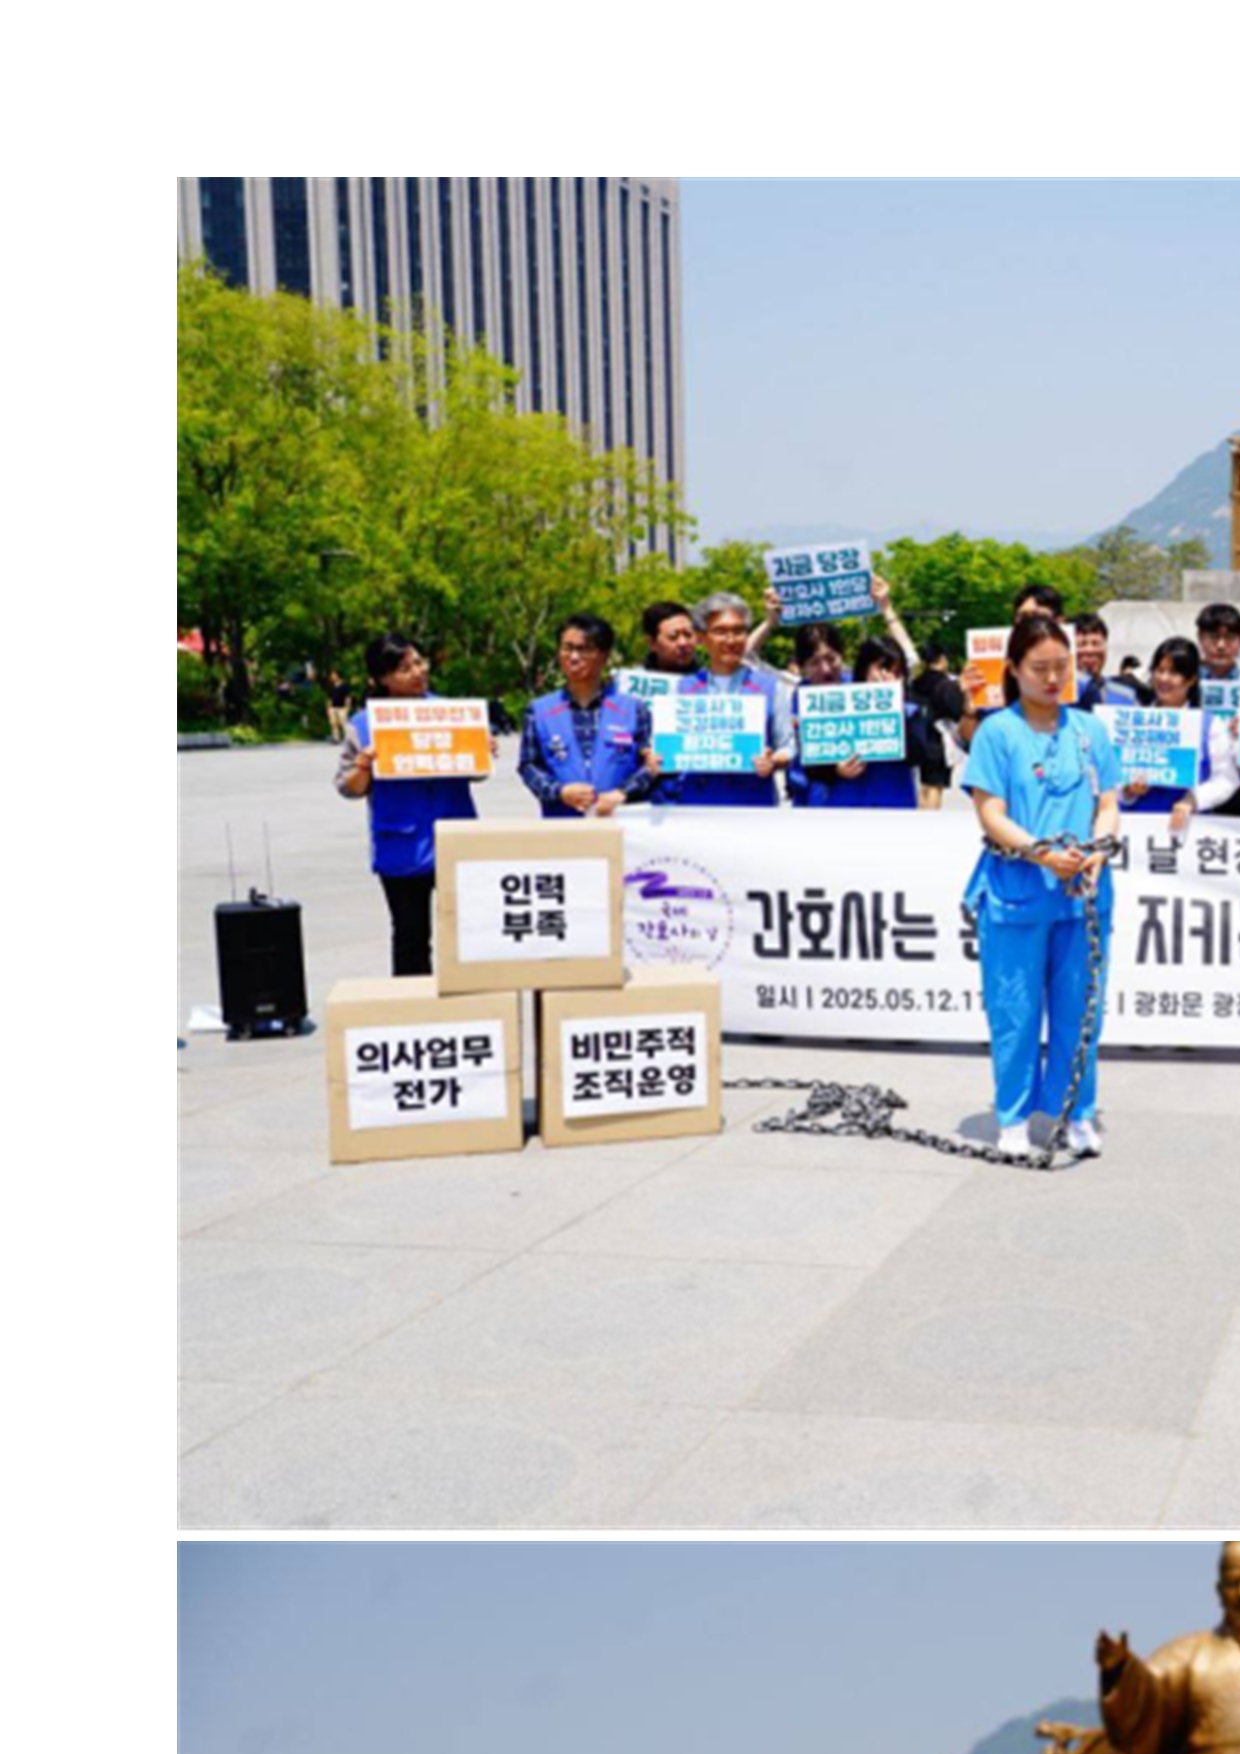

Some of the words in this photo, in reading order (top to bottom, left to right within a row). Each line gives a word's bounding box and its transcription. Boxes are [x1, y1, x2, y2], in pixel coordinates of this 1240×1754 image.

[1147, 837, 1183, 874] 날
[500, 873, 567, 905] 인력
[501, 911, 567, 943] 부족
[746, 888, 937, 961] 간호사는
[756, 985, 798, 1009] 일시
[1134, 991, 1204, 1018] 광화문
[356, 1035, 494, 1073] 의사업무
[571, 1026, 696, 1063] 비민주적
[393, 1077, 463, 1111] 전가
[572, 1065, 697, 1102] 조직운영
